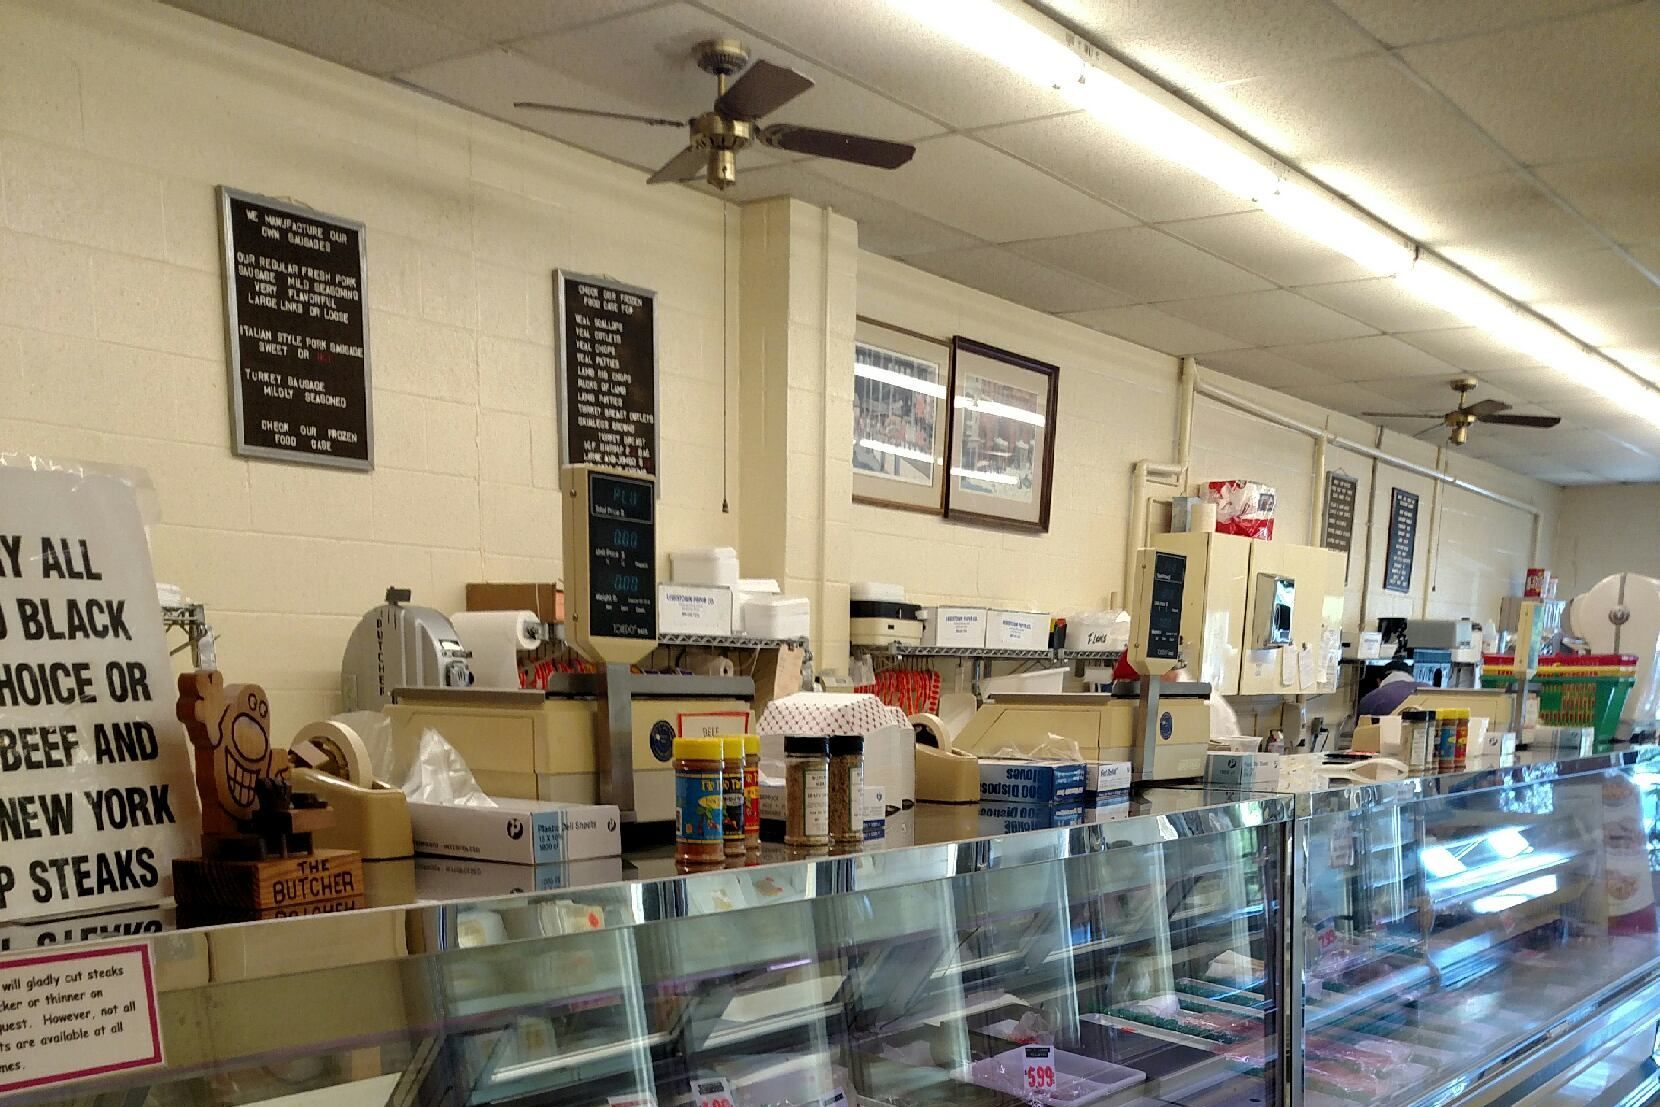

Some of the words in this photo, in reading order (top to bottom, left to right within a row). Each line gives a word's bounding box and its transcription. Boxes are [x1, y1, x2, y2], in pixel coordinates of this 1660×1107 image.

[246, 209, 258, 222] WE
[330, 230, 347, 245] OUR
[262, 226, 279, 240] OWN
[237, 251, 255, 265] OUR
[259, 256, 298, 275] REGULAR
[302, 266, 330, 282] FRESH
[336, 274, 356, 288] PORK
[239, 265, 275, 283] SAUSAGE
[288, 276, 309, 290] MILD
[314, 282, 358, 300] SEASONING
[255, 281, 277, 295] VERY
[248, 292, 277, 309] LARGE
[310, 306, 320, 318] OR
[324, 311, 349, 324] LOOSE
[240, 325, 272, 341] ITALIAN
[278, 332, 302, 347] STYLE
[306, 337, 327, 350] PORK
[259, 341, 287, 356] SWEET
[298, 348, 310, 360] OR
[245, 368, 282, 384] TURKEY
[288, 376, 326, 392] SAUSAGE
[264, 386, 294, 399] MILDLY
[305, 392, 347, 408] SEASONED
[262, 420, 289, 432] CHECK
[300, 425, 317, 437] OUR
[328, 429, 357, 443] FROZEN
[275, 434, 297, 446] FOOD
[311, 440, 332, 451] CASE
[41, 537, 102, 580] ALL
[16, 597, 132, 640] BLACK
[105, 660, 152, 703] OR
[0, 724, 79, 772] BEEF
[93, 720, 159, 764] AND
[0, 792, 73, 842] NEW
[84, 784, 176, 832] YORK
[29, 846, 159, 904] STEAKS
[297, 858, 330, 875] THE
[272, 871, 355, 905] BUTCHER
[2, 978, 21, 991] will
[26, 973, 60, 991] gladly
[64, 970, 82, 983] cut
[87, 965, 124, 979] steaks
[27, 998, 40, 1008] or
[45, 992, 86, 1005] thinner
[90, 989, 103, 999] on
[43, 1010, 96, 1026] However,
[101, 1004, 118, 1016] not
[123, 1001, 136, 1013] all
[16, 1038, 36, 1050] are
[40, 1028, 89, 1046] available
[94, 1027, 105, 1037] at
[111, 1021, 123, 1033] all
